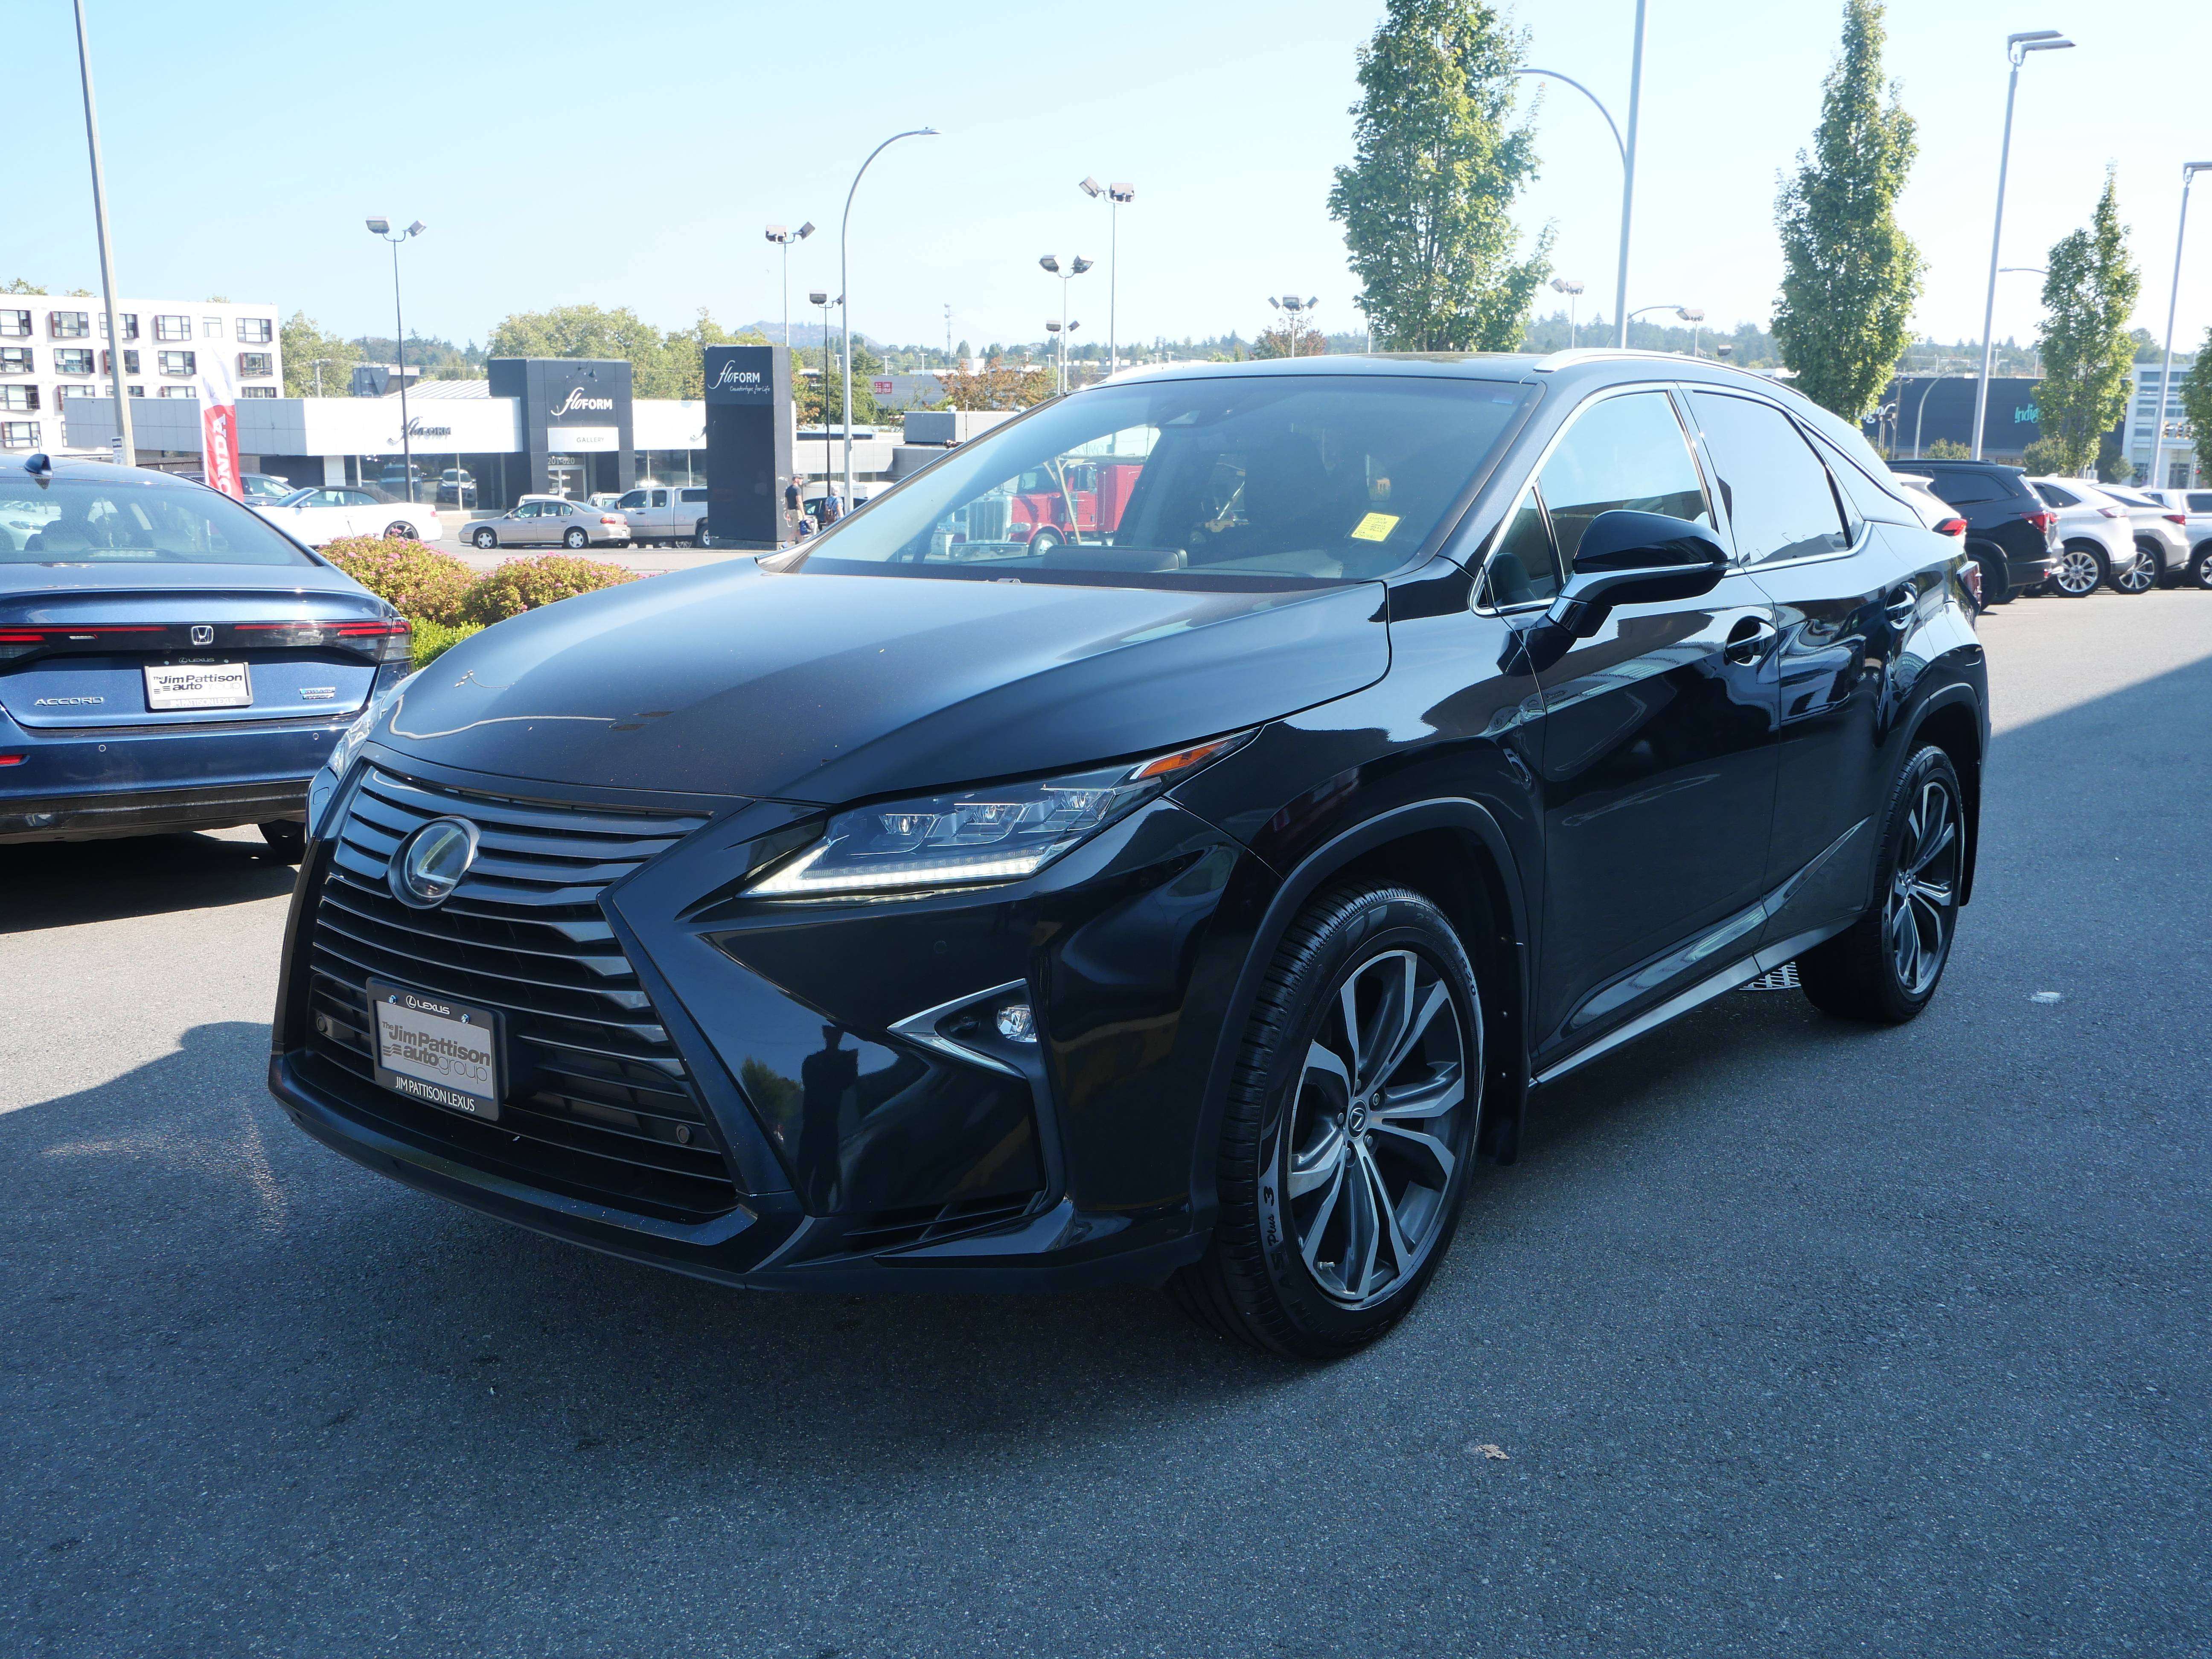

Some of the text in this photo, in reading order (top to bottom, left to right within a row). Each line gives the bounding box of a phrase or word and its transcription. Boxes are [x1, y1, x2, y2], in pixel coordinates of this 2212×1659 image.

[707, 360, 760, 389] floFORM
[551, 387, 613, 416] floFORM
[762, 385, 770, 394] Life
[213, 413, 232, 496] ONDA
[159, 675, 184, 684] Jim
[186, 674, 242, 683] Pattison
[34, 696, 104, 706] ACCORD
[182, 698, 213, 707] PATTISON
[416, 1000, 450, 1015] LEXUS
[382, 1021, 490, 1066] The Jim Pattison
[395, 1076, 475, 1112] JIM PATTISON LEXUS
[1263, 1185, 1275, 1206] 3
[1267, 1214, 1278, 1247] Plus
